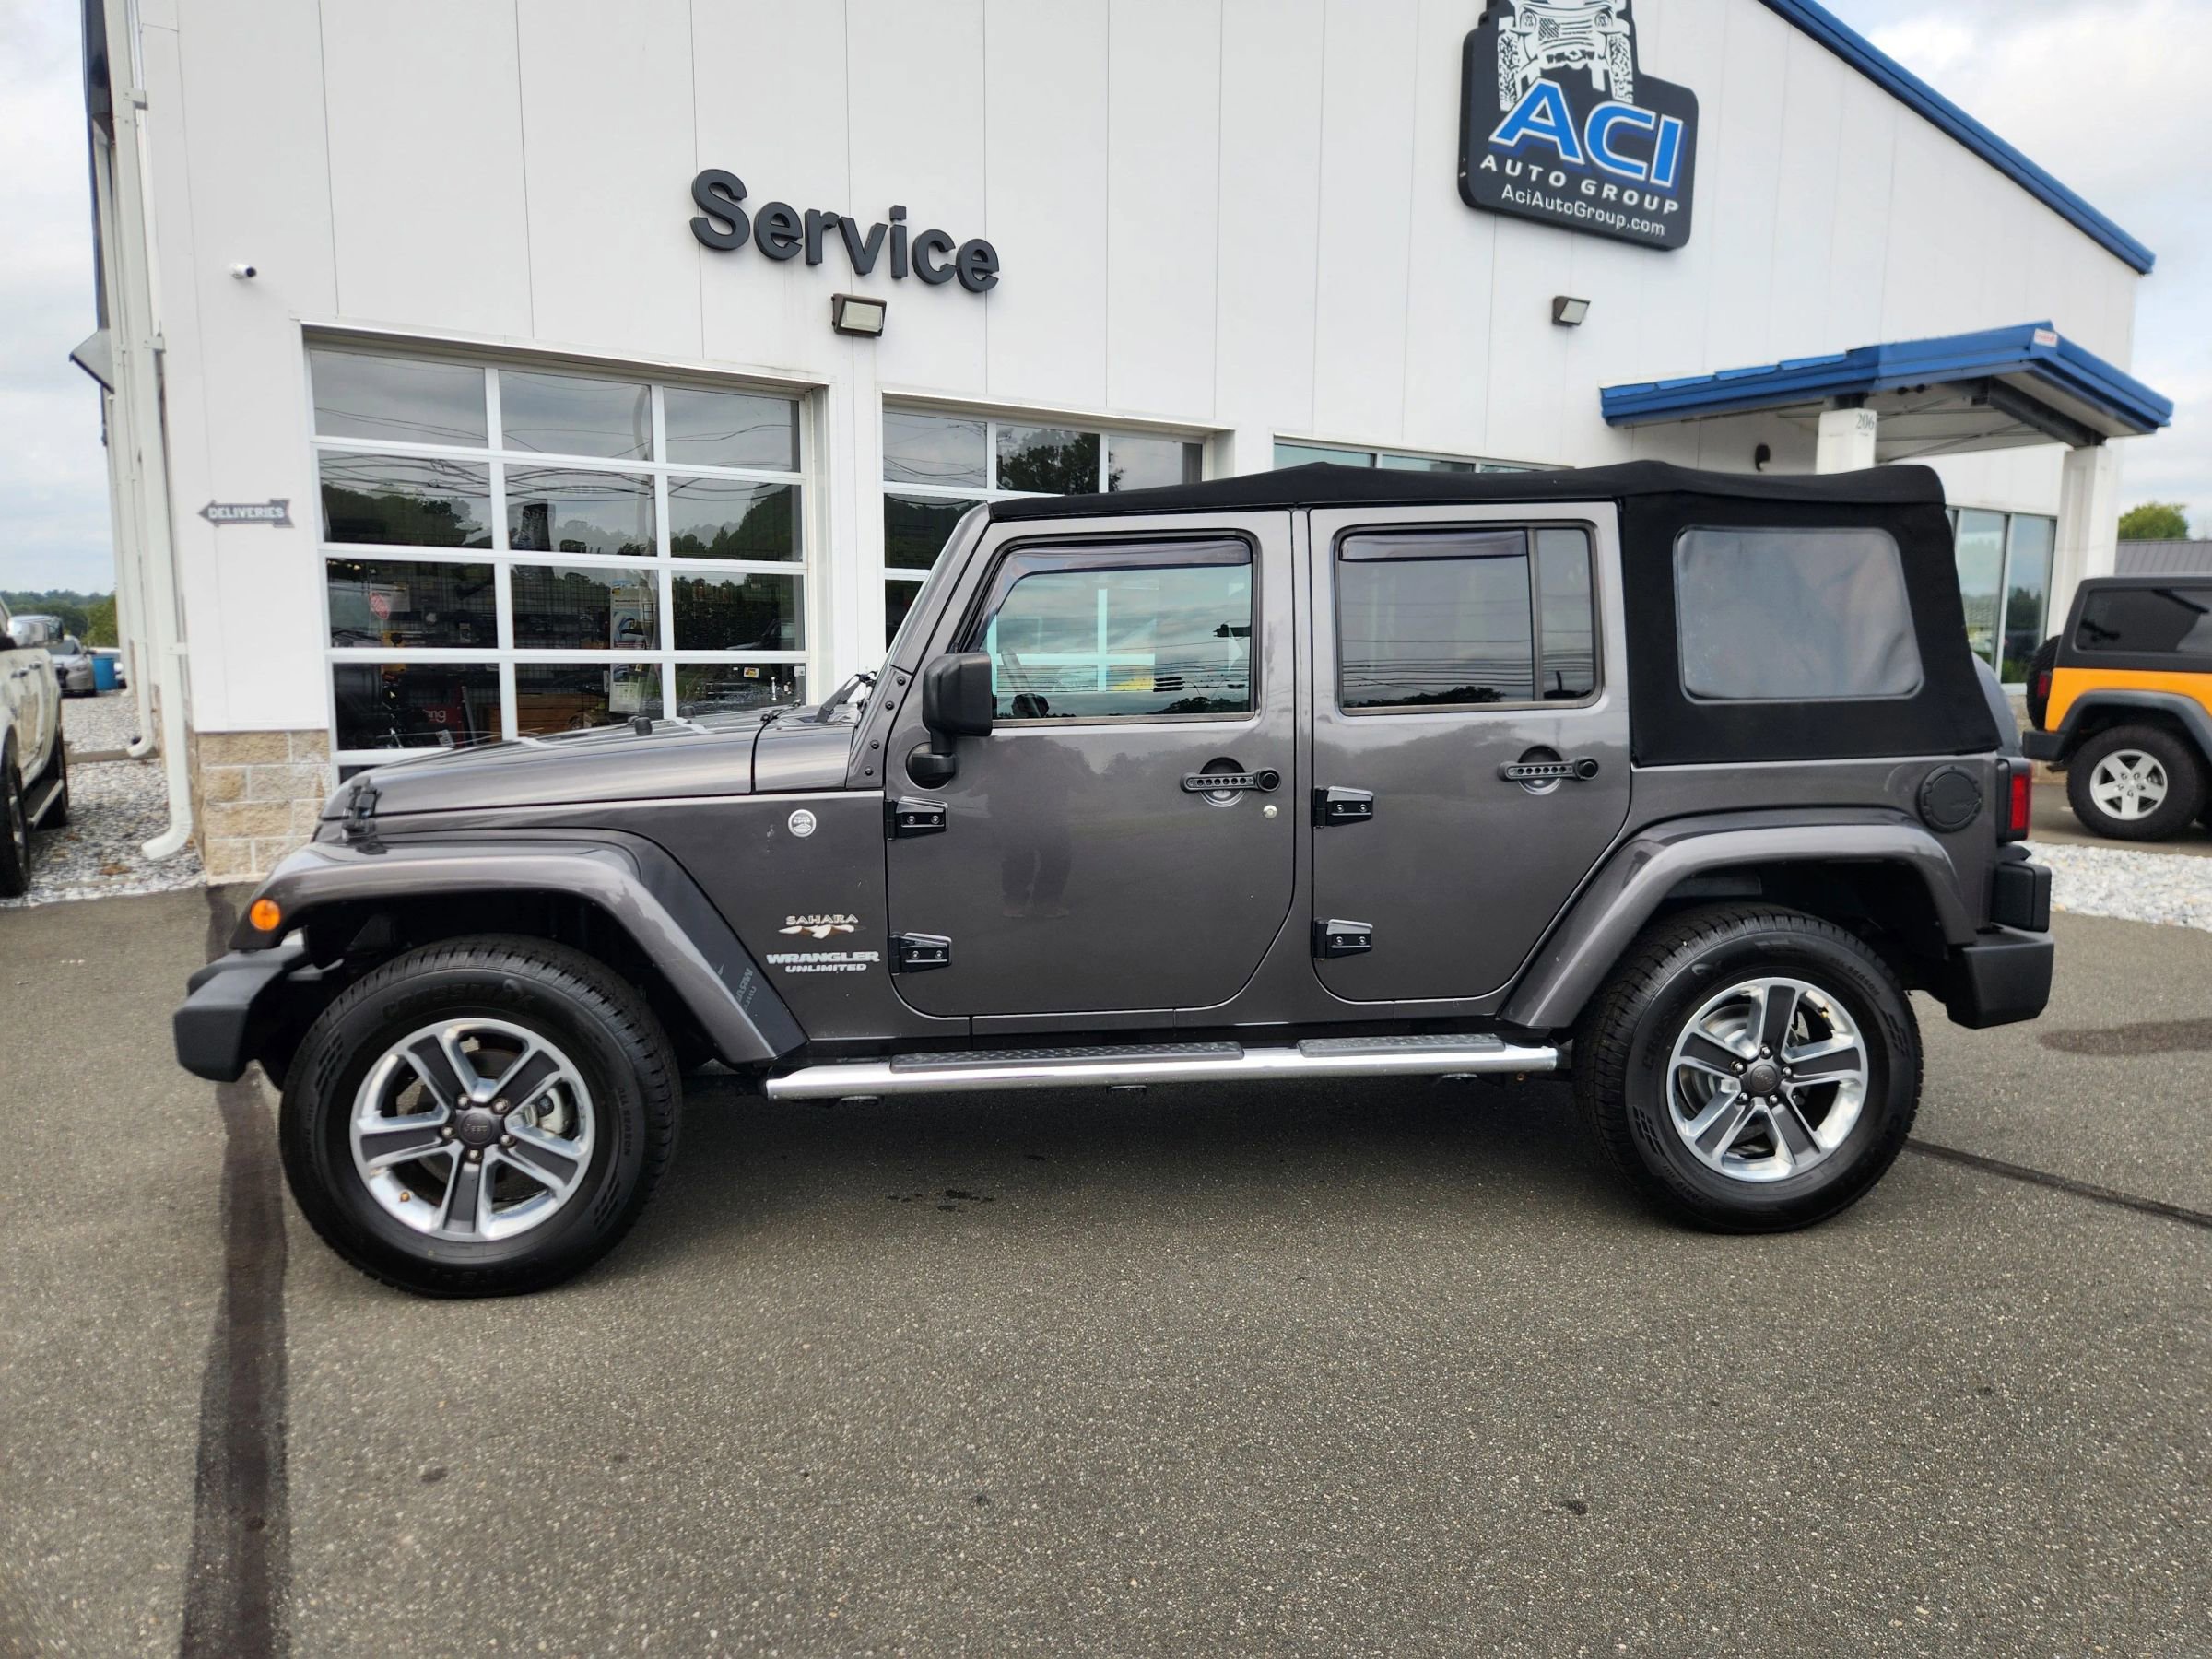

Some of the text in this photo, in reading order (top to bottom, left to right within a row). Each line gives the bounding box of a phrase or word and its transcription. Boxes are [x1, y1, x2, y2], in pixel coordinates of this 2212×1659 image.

[1488, 77, 1684, 188] ACI
[1480, 154, 1680, 216] AUTO GROUP
[1500, 182, 1666, 237] AciAutoGroup.com
[689, 162, 1000, 293] Service
[1856, 412, 1875, 431] 206
[207, 507, 285, 519] DELIVERIES
[785, 913, 859, 926] SAHARA
[766, 950, 881, 965] WRANGLER
[784, 963, 868, 973] UNLIMITED
